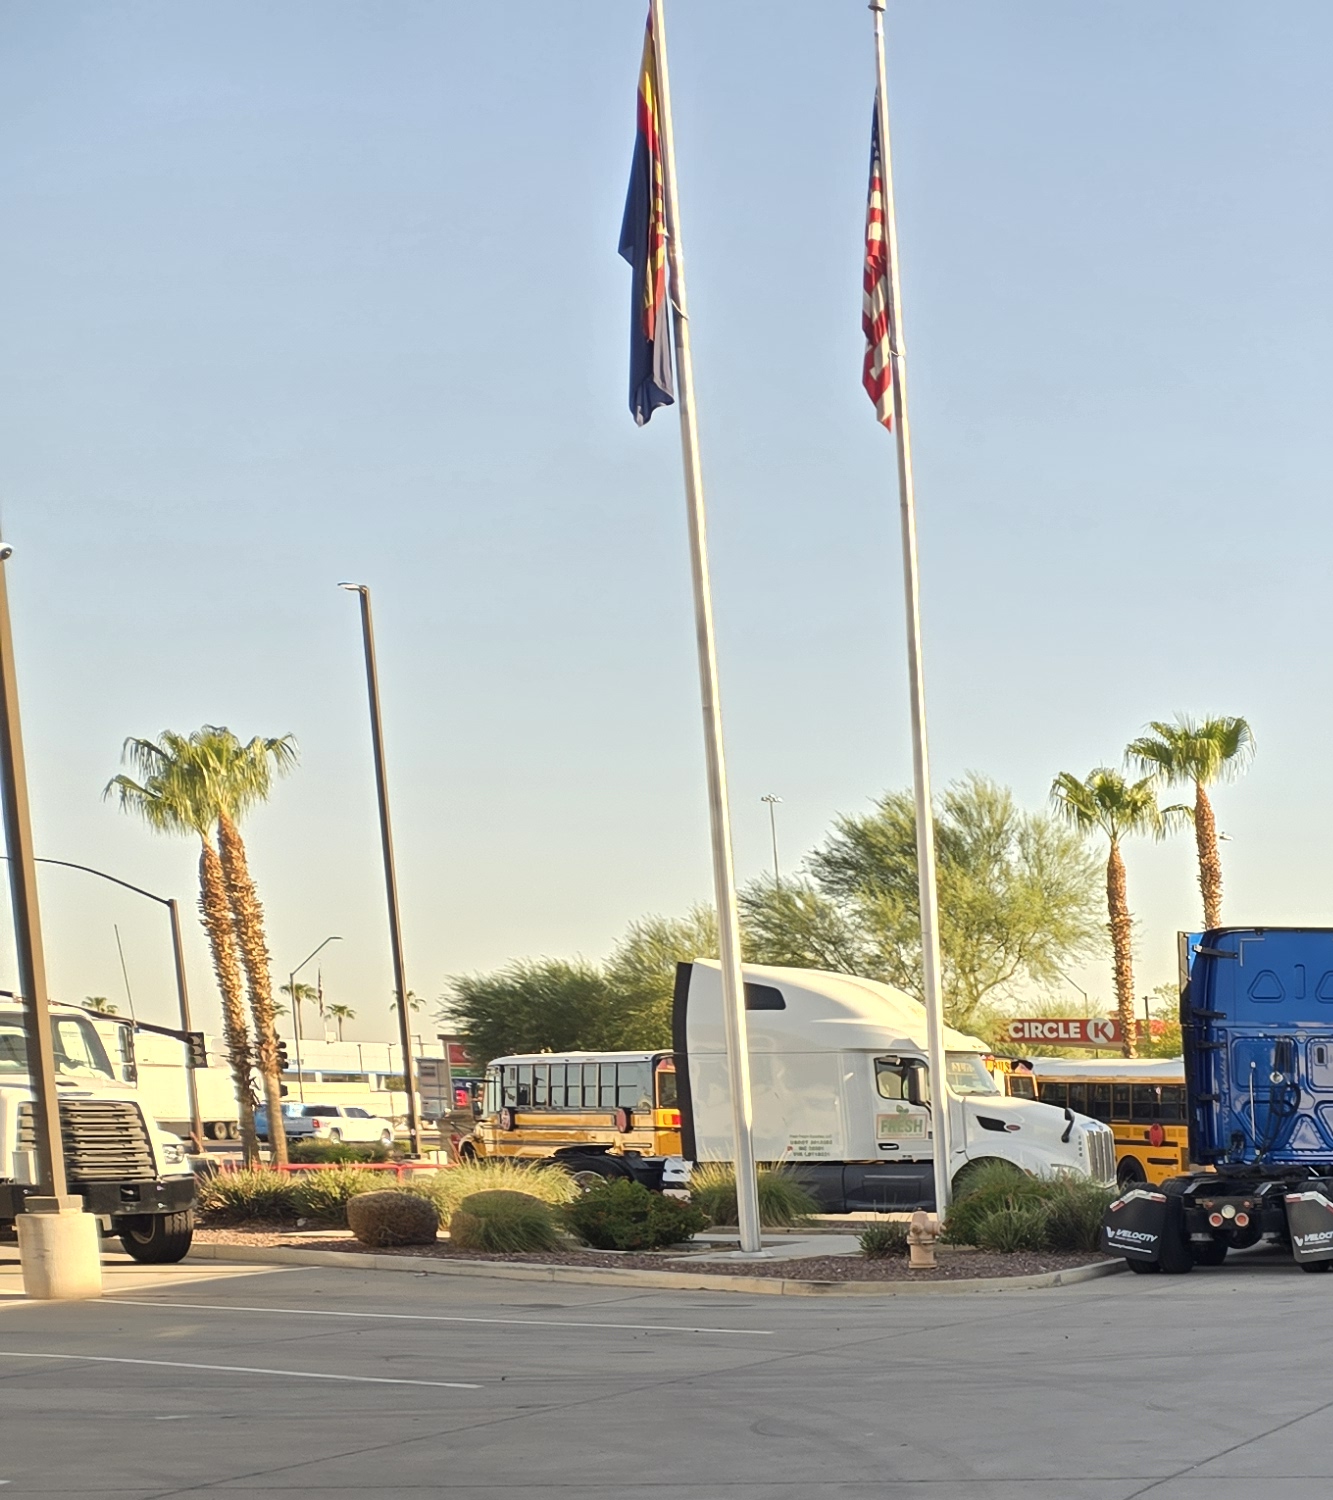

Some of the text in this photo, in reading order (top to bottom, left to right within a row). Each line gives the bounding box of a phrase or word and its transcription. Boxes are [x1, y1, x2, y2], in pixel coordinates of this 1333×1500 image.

[1007, 1020, 1113, 1042] CIRCLE K
[880, 1119, 924, 1133] FRESH
